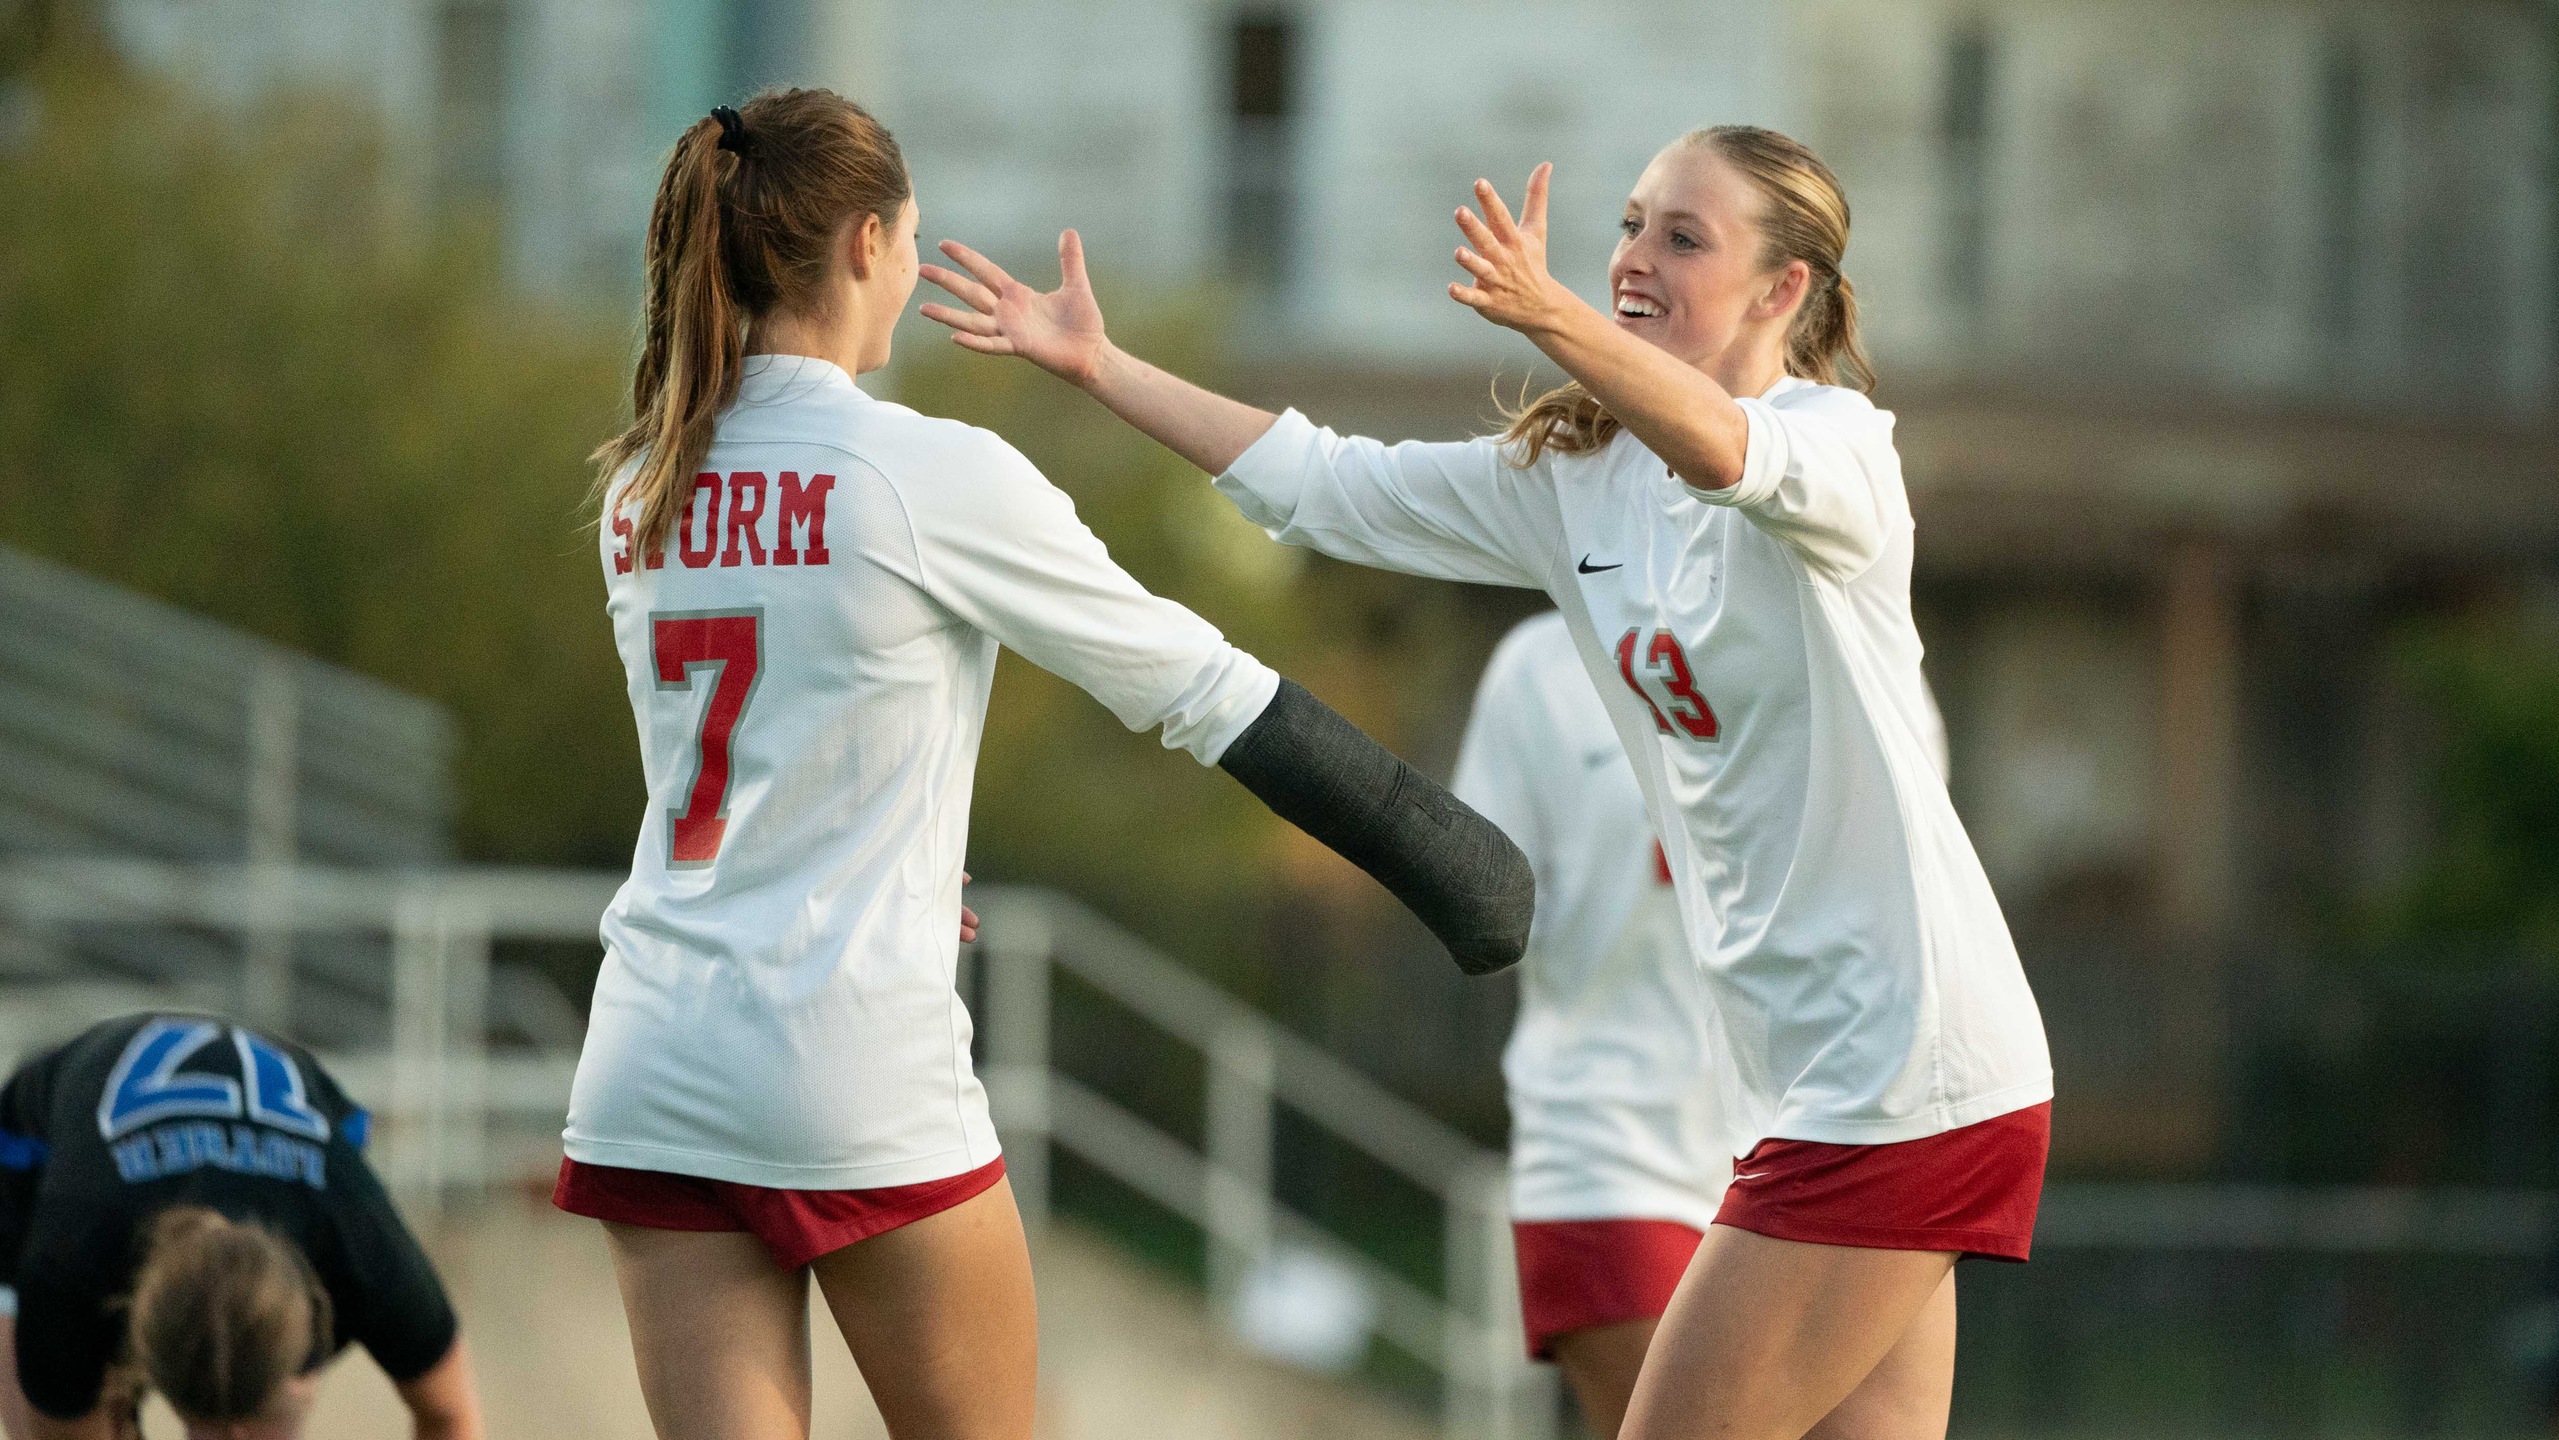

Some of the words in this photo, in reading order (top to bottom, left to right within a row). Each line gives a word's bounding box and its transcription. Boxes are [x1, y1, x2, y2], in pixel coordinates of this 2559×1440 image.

[611, 471, 836, 576] SORM
[648, 606, 766, 871] 7
[1613, 626, 1722, 743] 13
[96, 1017, 331, 1144] 17
